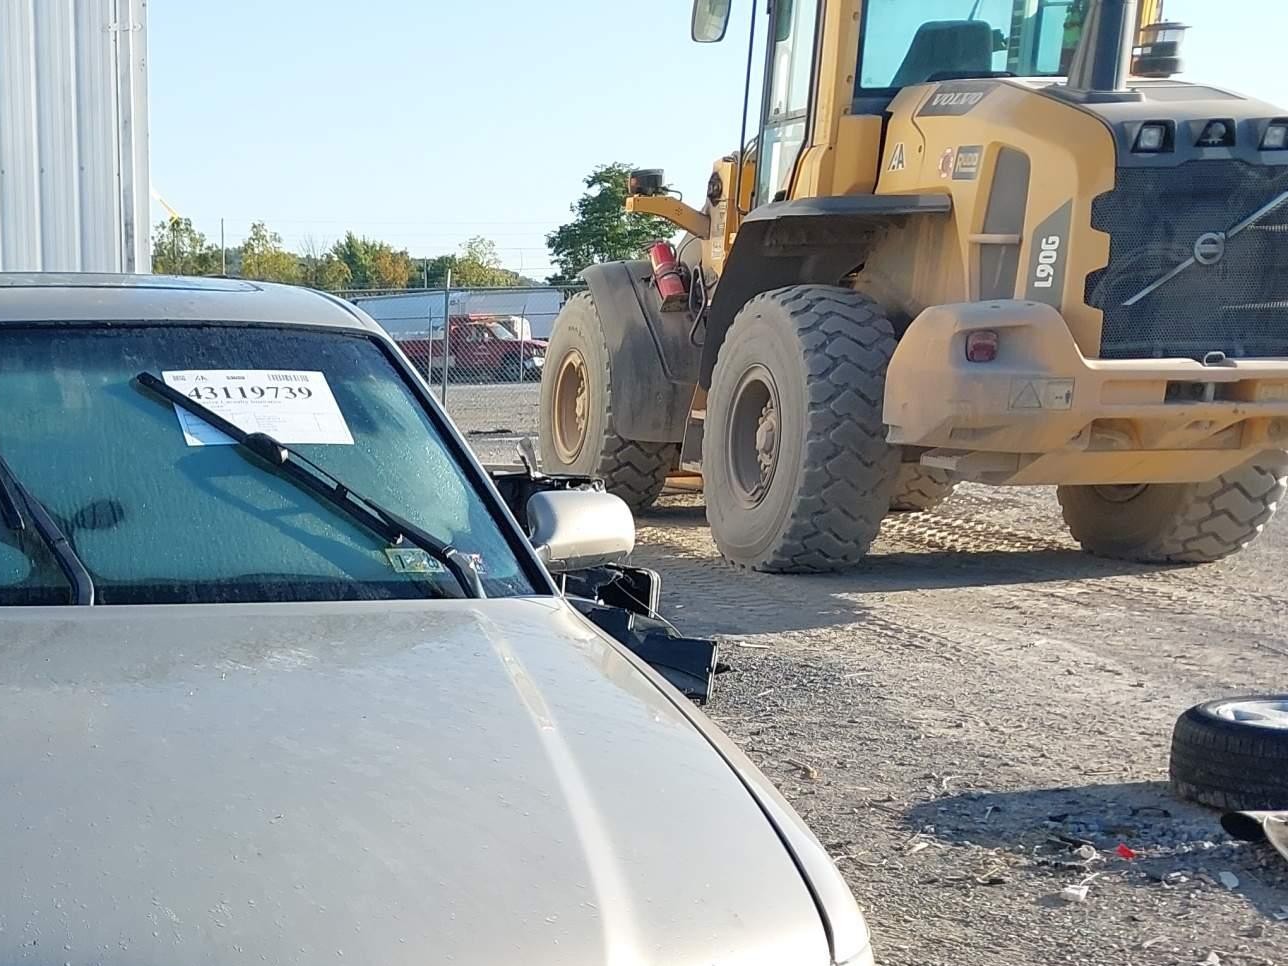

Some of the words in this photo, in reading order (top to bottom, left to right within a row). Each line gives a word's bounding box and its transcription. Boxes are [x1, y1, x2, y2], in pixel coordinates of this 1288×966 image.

[932, 92, 984, 106] VOLVO
[1034, 235, 1060, 288] L90G
[188, 386, 313, 400] 43119739
